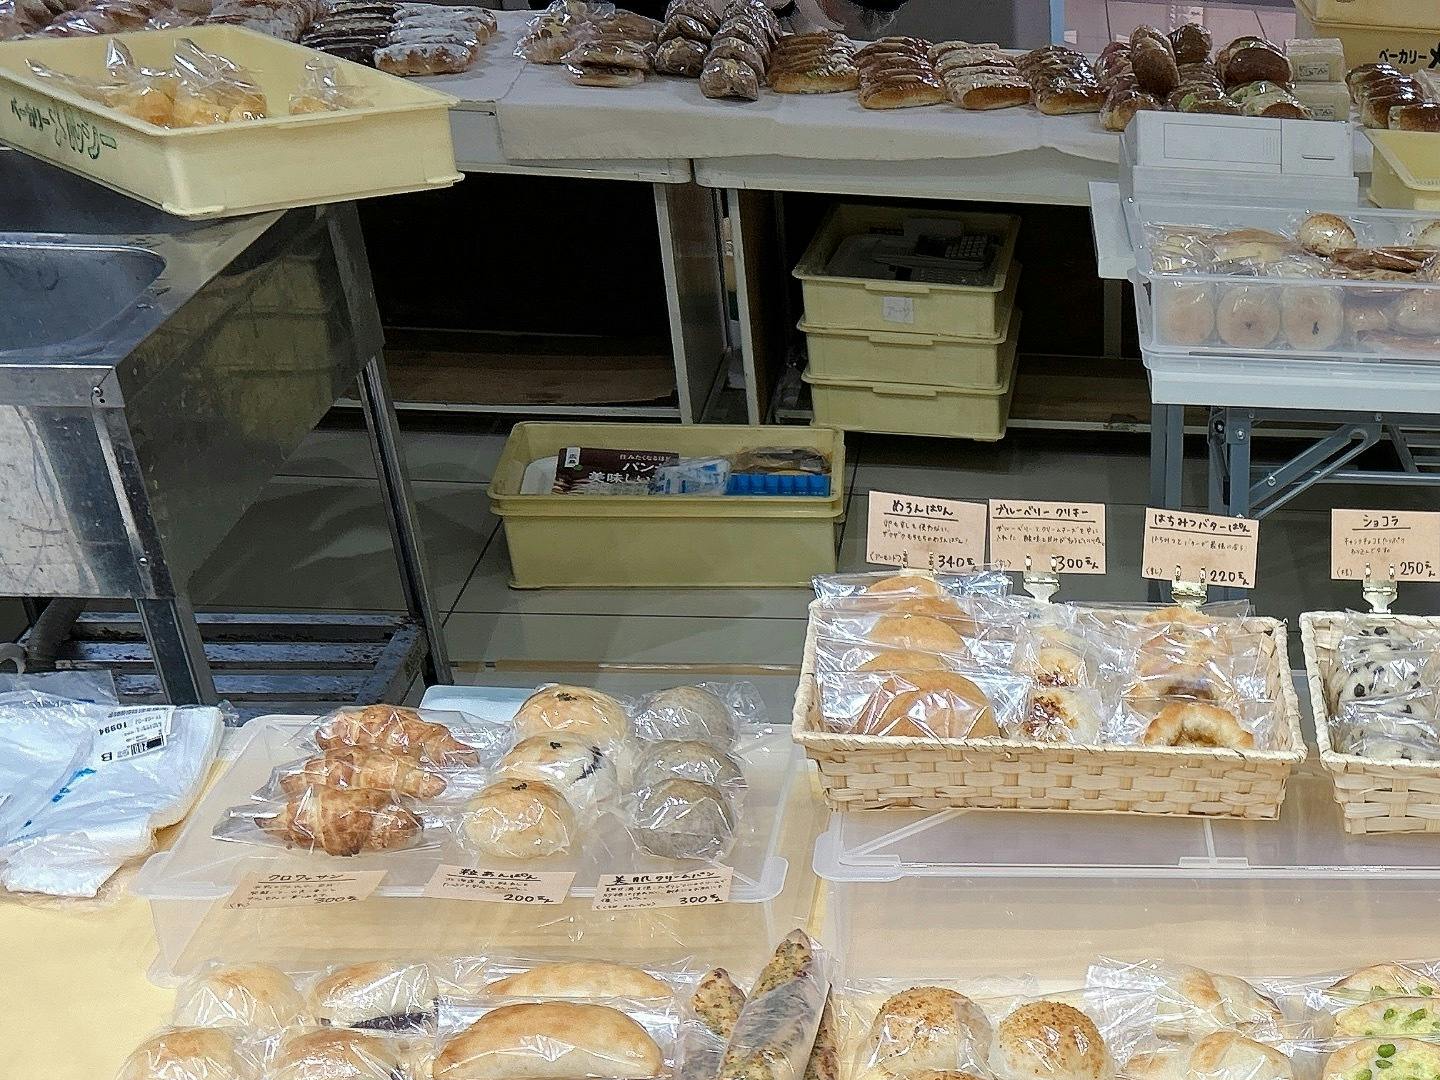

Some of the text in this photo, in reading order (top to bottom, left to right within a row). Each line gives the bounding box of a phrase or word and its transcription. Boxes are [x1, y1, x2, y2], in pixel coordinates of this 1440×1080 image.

[1379, 48, 1427, 64] ベーカリー
[892, 500, 954, 516] めろんぱん
[1154, 514, 1251, 533] はちみつバターぱん
[1363, 514, 1399, 528] ショコラ
[101, 751, 113, 762] B
[268, 873, 345, 882] クロワッサン
